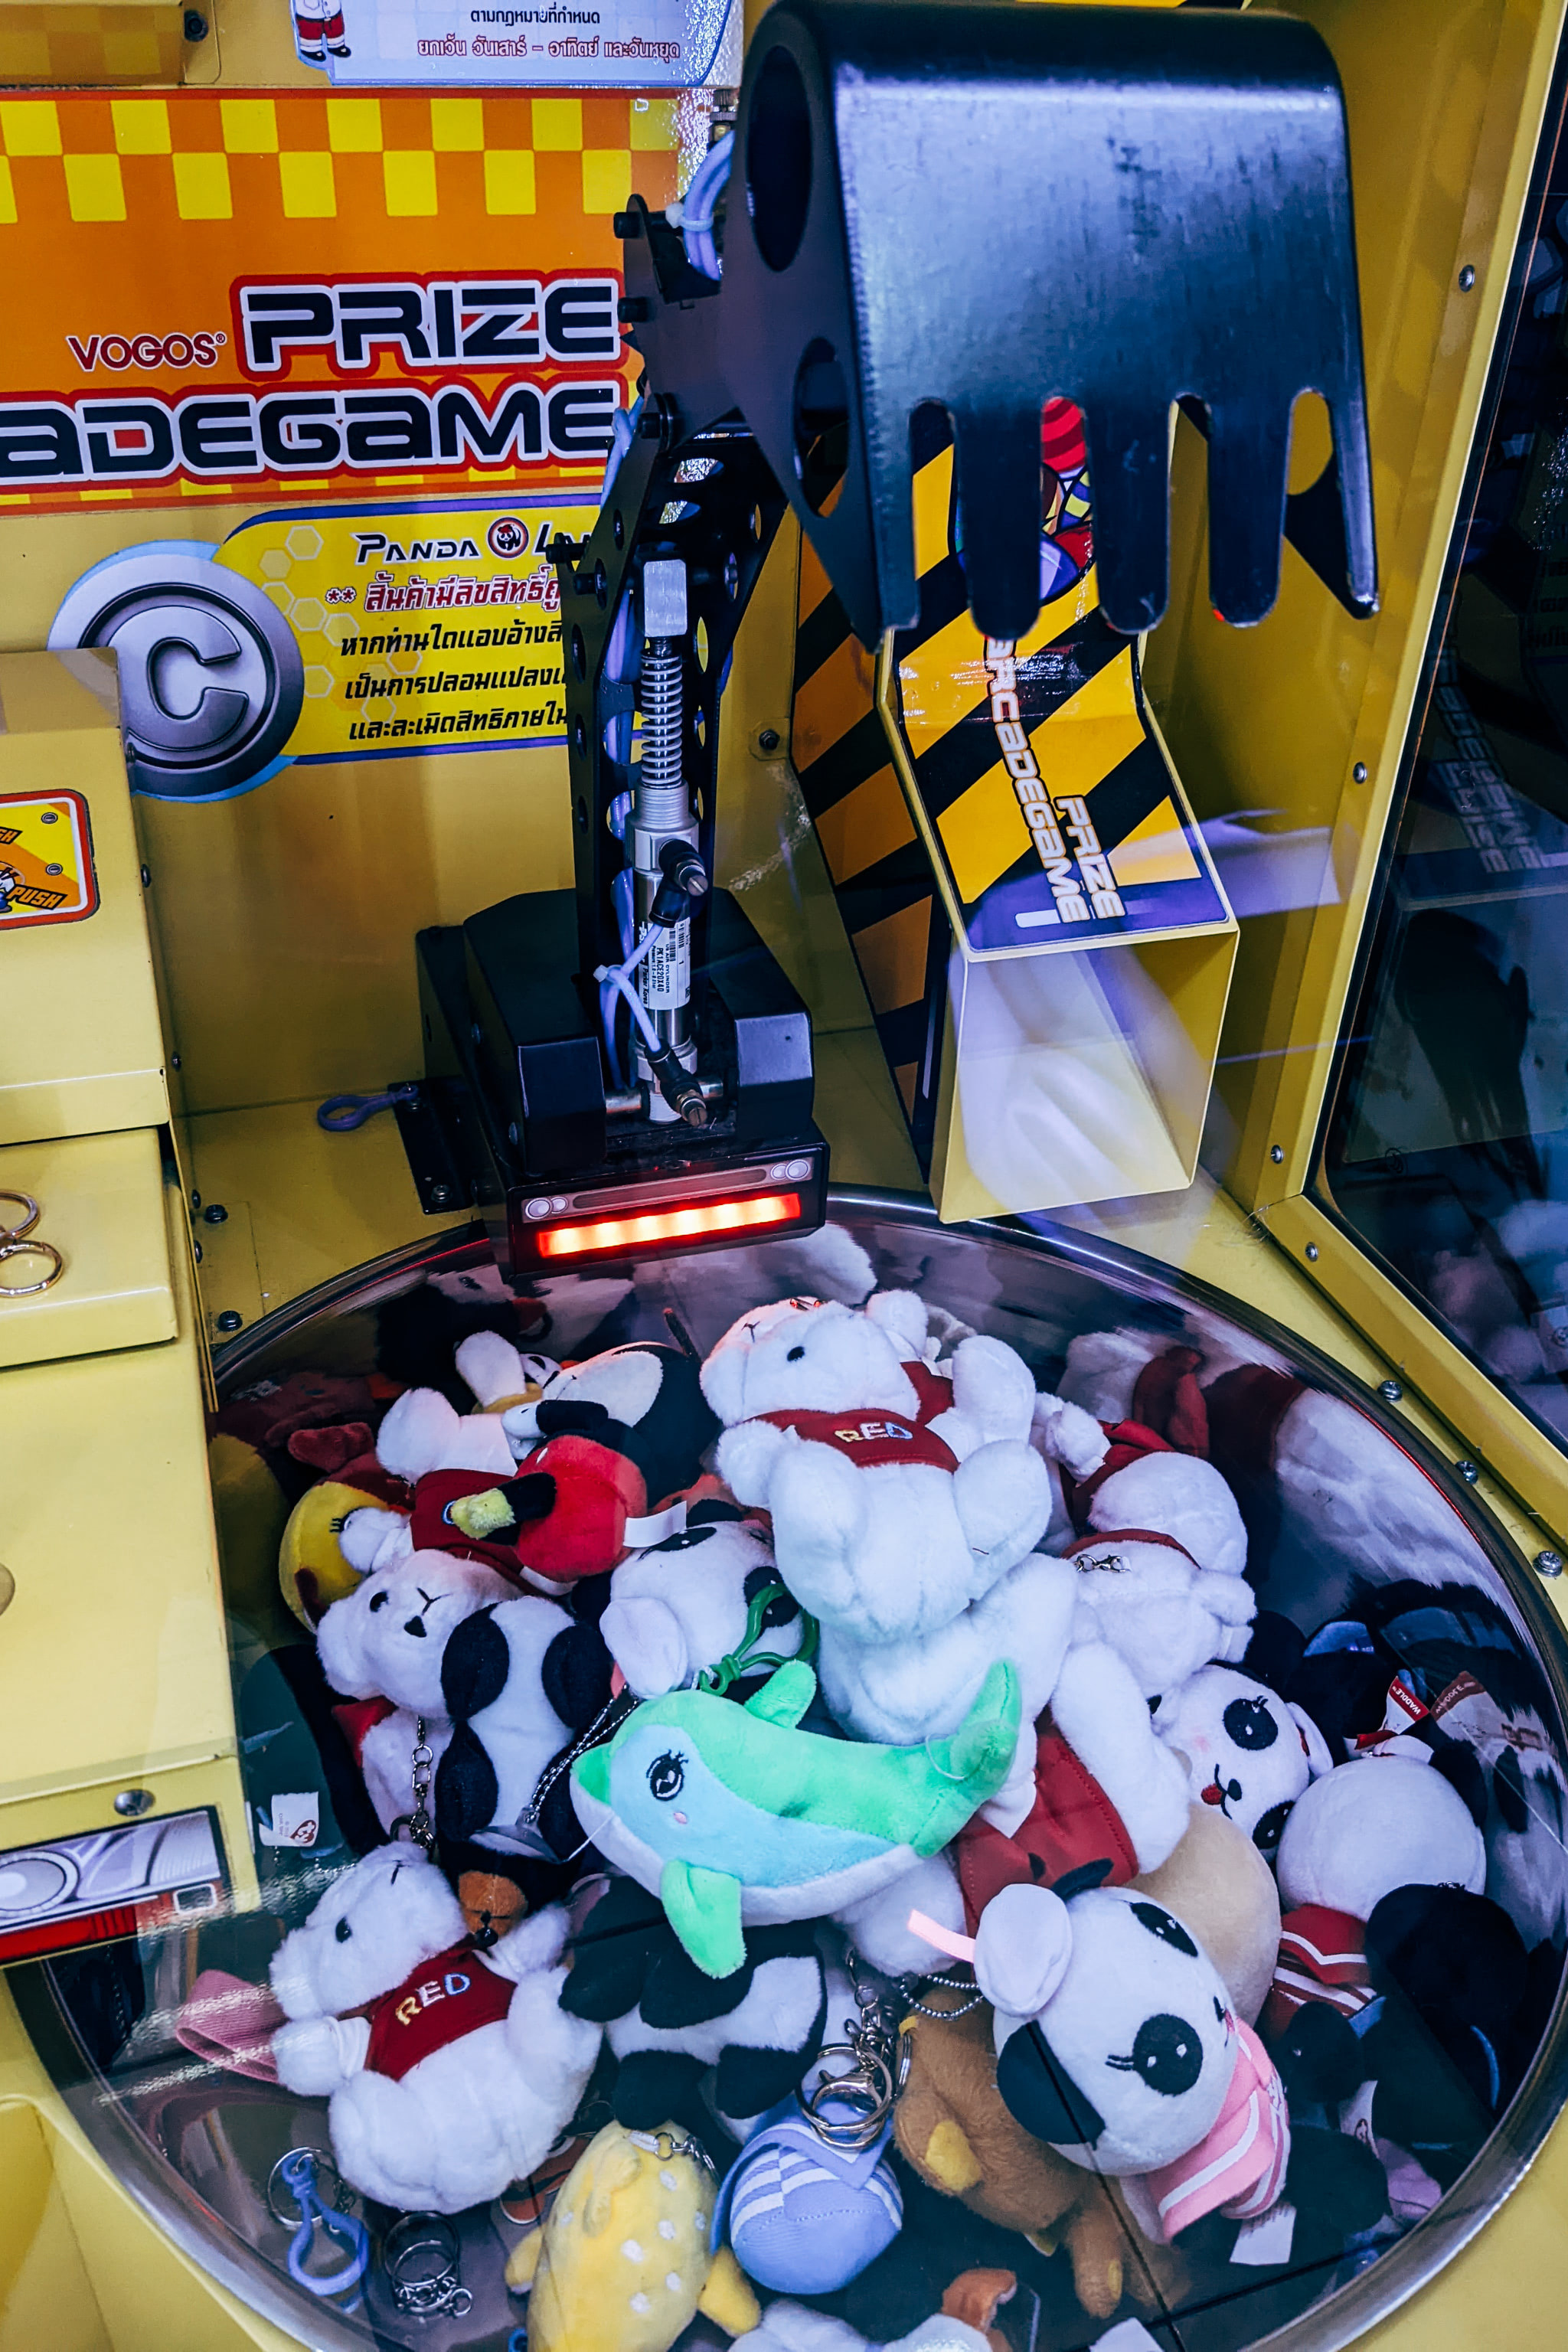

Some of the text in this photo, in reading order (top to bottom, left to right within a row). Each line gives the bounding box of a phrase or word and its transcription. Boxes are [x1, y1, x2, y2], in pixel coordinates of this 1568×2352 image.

[417, 34, 467, 57] ยกเว้น
[472, 35, 528, 57] วันเสาร์
[548, 36, 599, 58] อาทิตย์
[603, 38, 681, 64] และวันหยุด
[243, 281, 616, 370] PRIZE
[1057, 795, 1126, 920] PRIZE
[6, 886, 64, 908] PUSH
[835, 1421, 913, 1443] RED
[395, 1972, 471, 2026] RED
